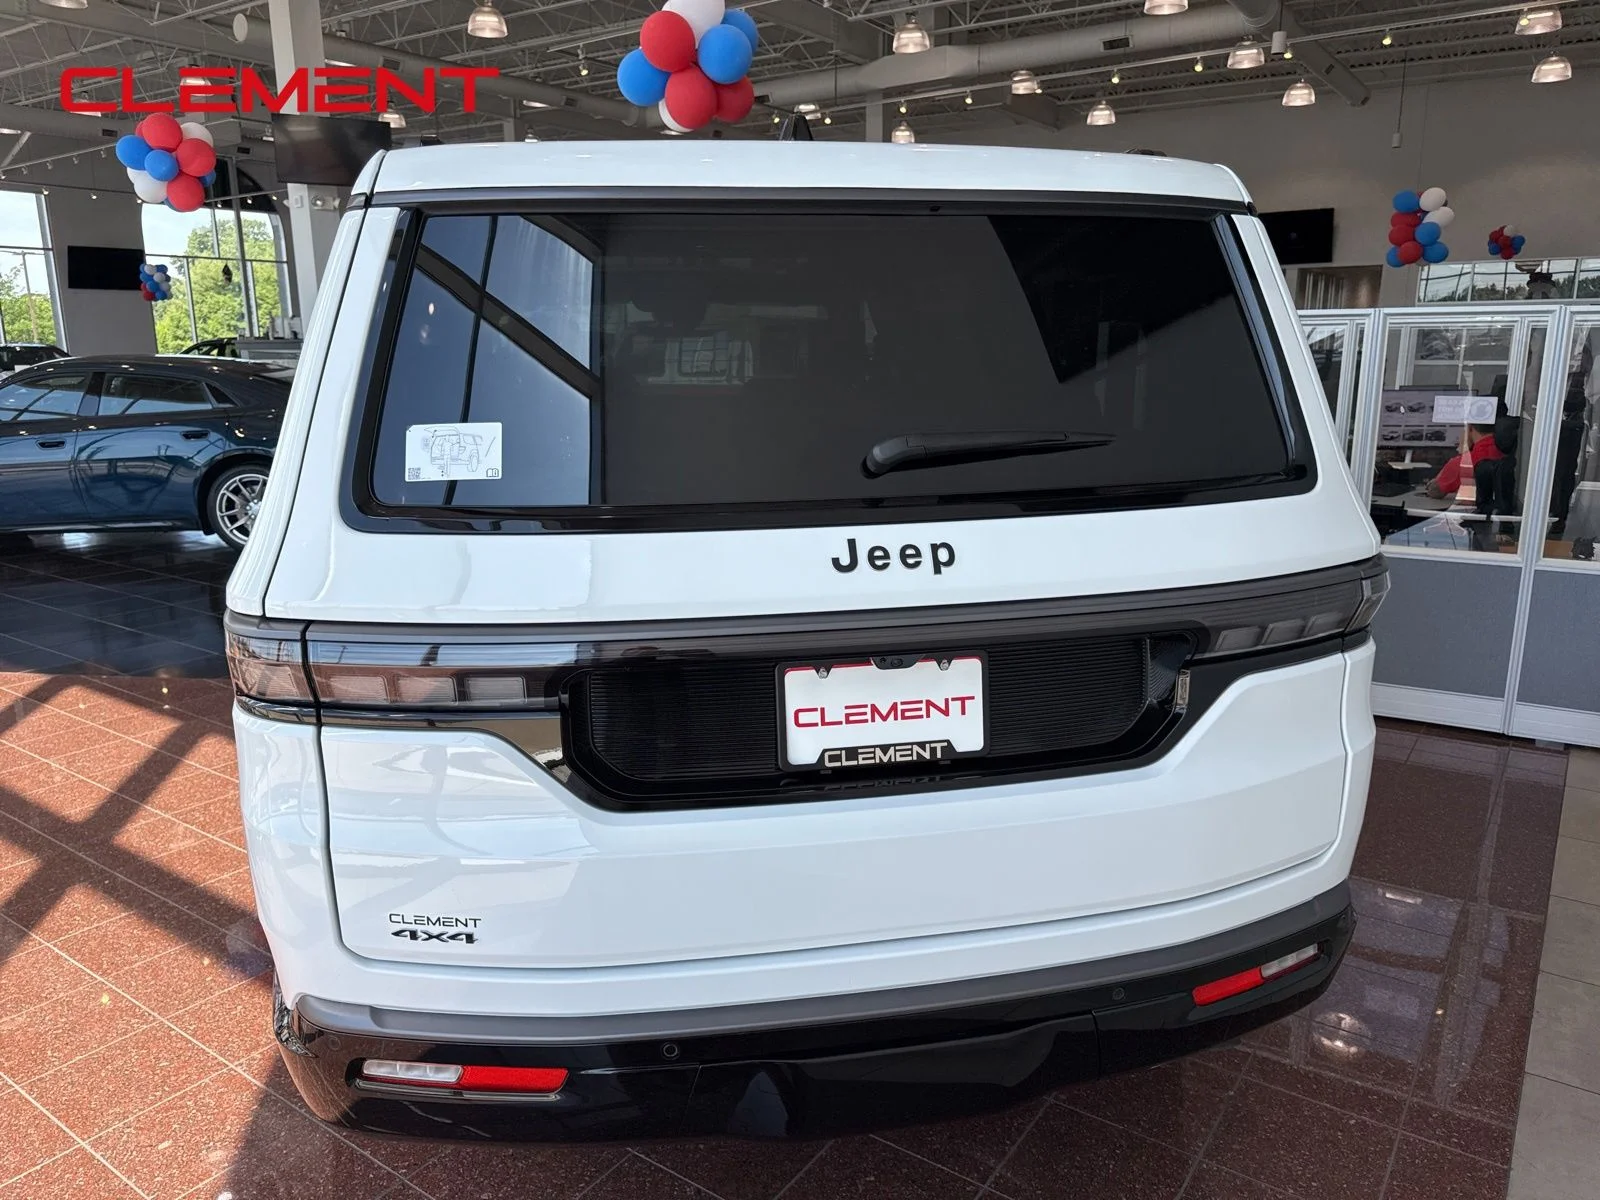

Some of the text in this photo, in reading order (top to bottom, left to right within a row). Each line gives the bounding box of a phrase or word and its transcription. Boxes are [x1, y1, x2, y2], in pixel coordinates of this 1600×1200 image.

[831, 538, 956, 575] Jeep
[793, 696, 975, 728] CLEMENT
[824, 742, 948, 767] CLEMENT
[389, 913, 481, 928] CLEMENT
